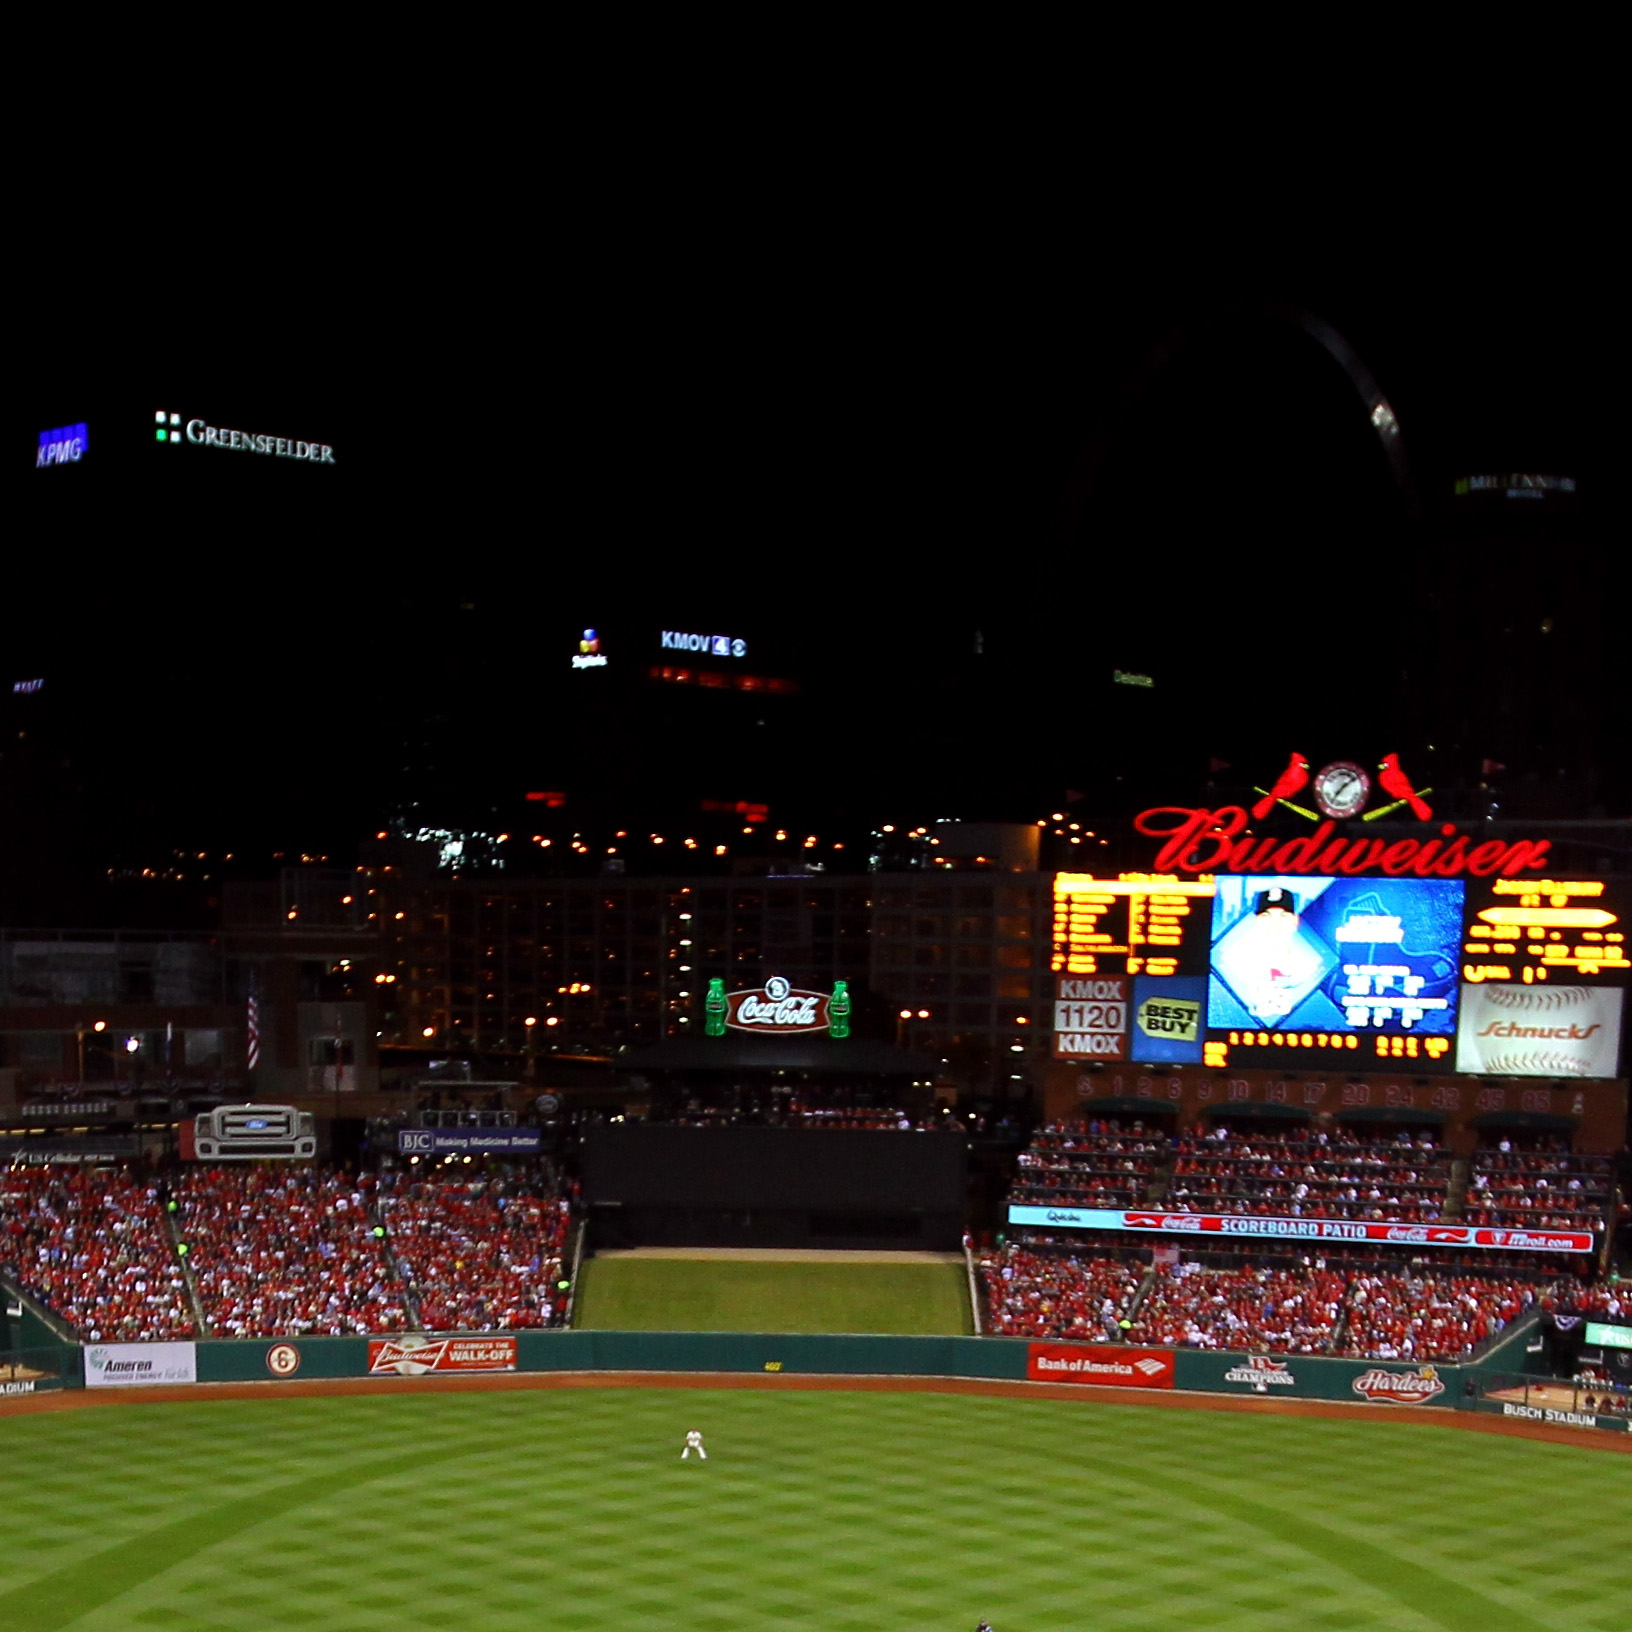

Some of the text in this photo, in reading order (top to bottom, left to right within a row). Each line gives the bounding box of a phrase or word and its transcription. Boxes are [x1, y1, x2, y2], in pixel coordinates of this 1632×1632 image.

[186, 419, 336, 465] GREENSFELDER
[36, 437, 83, 468] KPMG
[661, 630, 711, 652] KMOV
[1134, 807, 1552, 875] Budweiser
[1060, 980, 1122, 1000] KMOX
[737, 995, 820, 1025] Coca-Cola
[1060, 1005, 1121, 1029] 1120
[1147, 1004, 1197, 1021] BEST
[1147, 1018, 1191, 1034] BUY
[1477, 1021, 1601, 1040] Schnucks
[1058, 1033, 1120, 1054] KMOX
[404, 1134, 538, 1148] BJC Making Medicine Better
[1221, 1218, 1318, 1237] SCOREBOARD
[1325, 1223, 1367, 1239] PATIO
[276, 1349, 291, 1368] 6
[373, 1348, 445, 1362] Budweiser
[449, 1349, 515, 1362] WALK-OFF
[104, 1359, 152, 1373] Ameren
[1038, 1357, 1133, 1375] Bank of America
[1225, 1371, 1295, 1385] CHAMPIONS
[1503, 1403, 1596, 1427] BUSCH STADIUM
